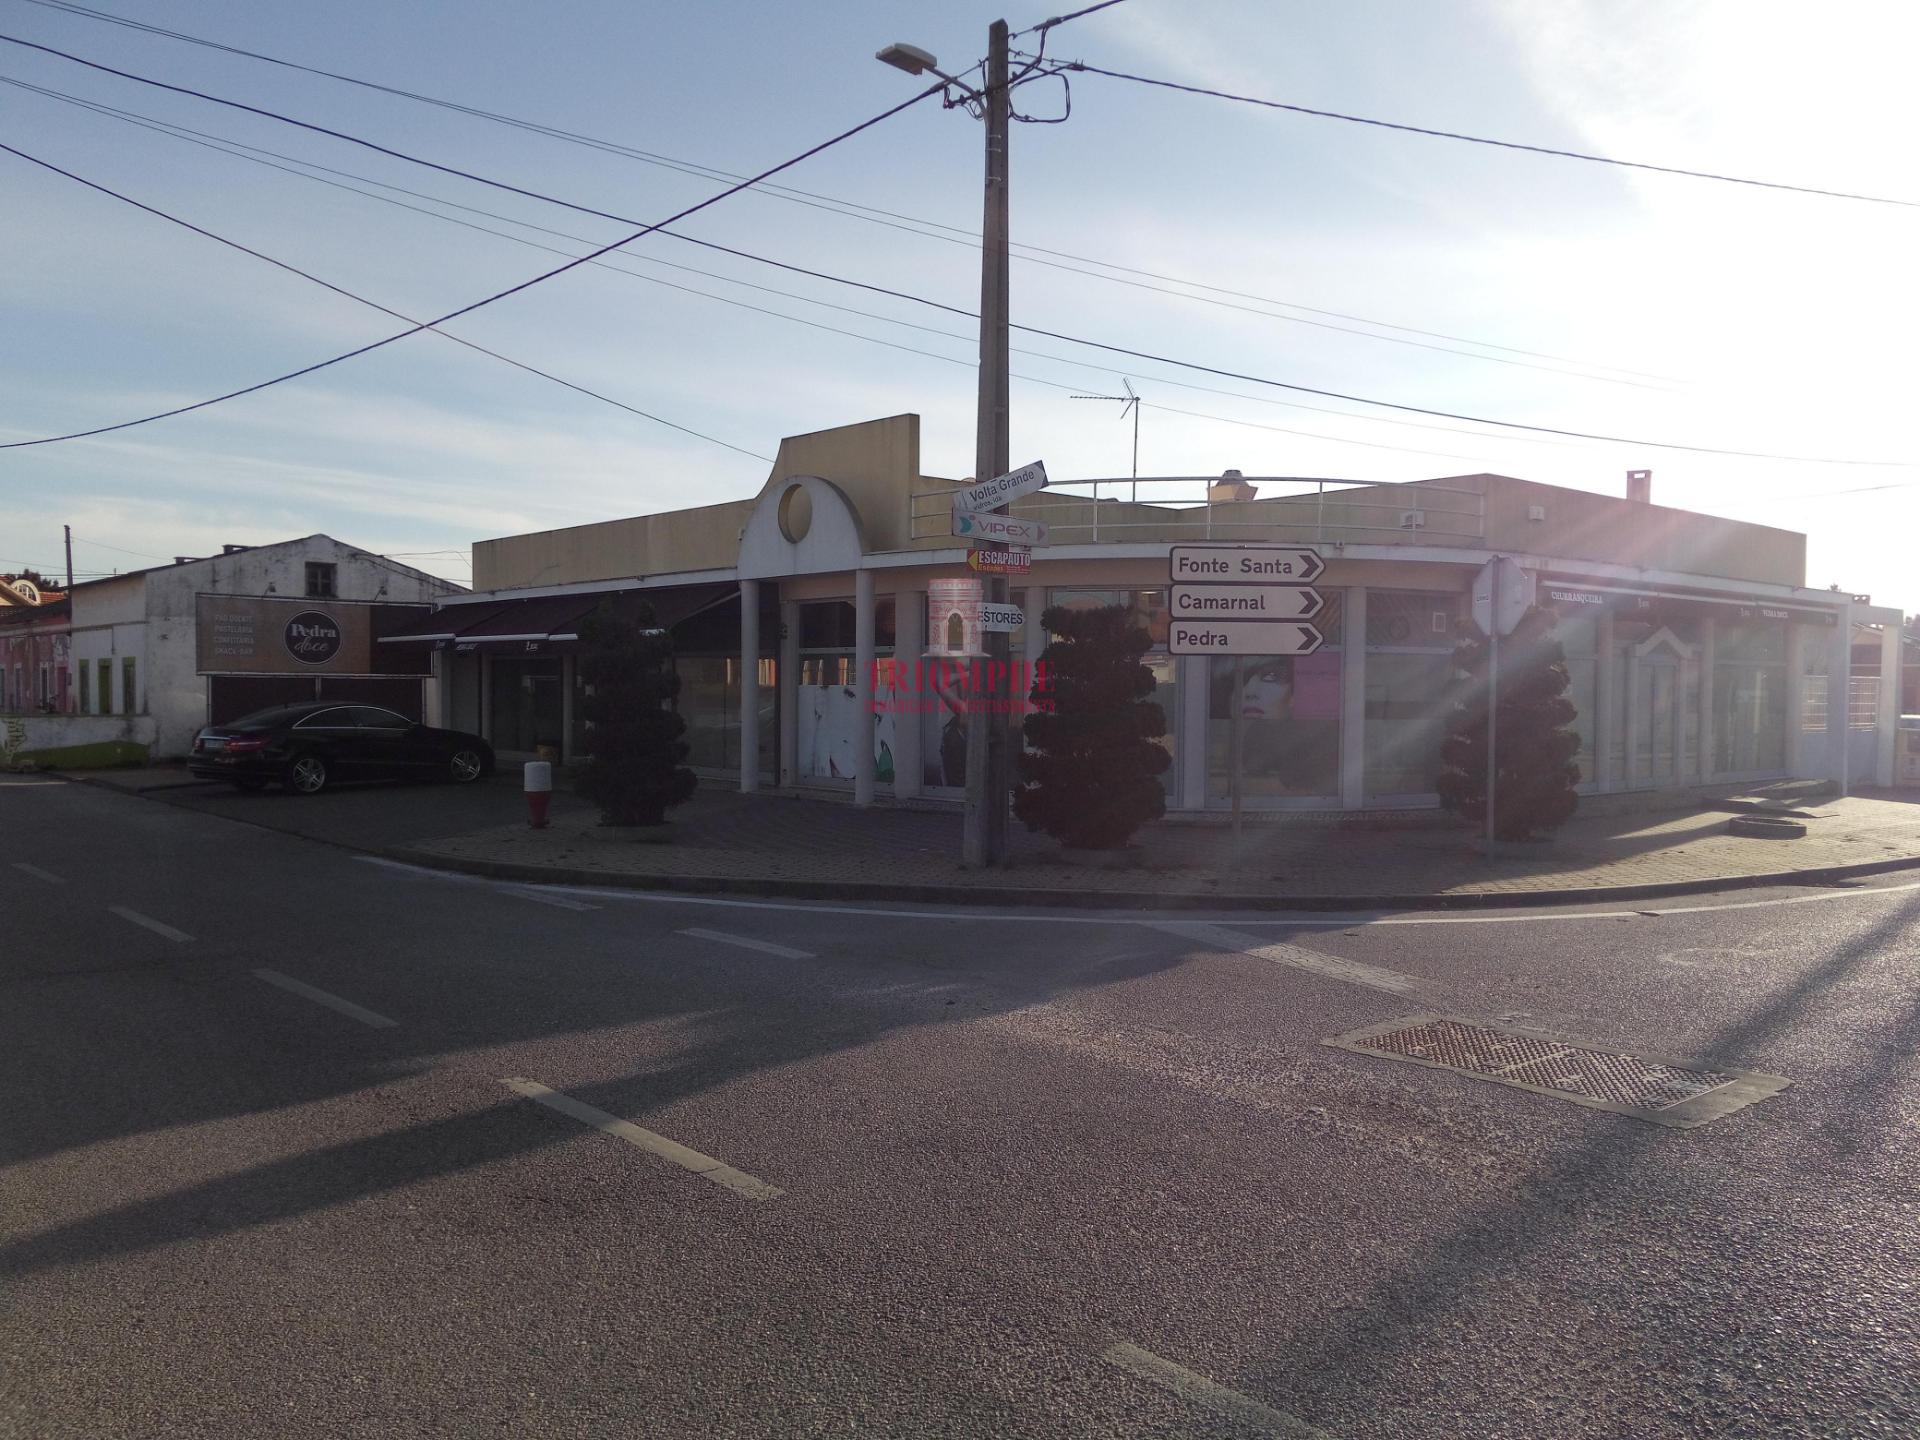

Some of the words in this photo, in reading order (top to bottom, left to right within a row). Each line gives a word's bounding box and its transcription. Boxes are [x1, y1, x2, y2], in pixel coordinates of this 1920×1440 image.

[969, 485, 998, 502] Volta
[998, 470, 1035, 491] Grande
[978, 520, 1031, 538] VIPEX
[978, 550, 1031, 566] ESCAPAUTO
[1178, 557, 1229, 573] Fonte
[1240, 558, 1292, 574] Santa
[1178, 594, 1266, 610] Camarnal
[1551, 591, 1604, 604] CHURRASQUEIRA
[977, 610, 1023, 625] ESTORES
[291, 623, 336, 638] Pedra
[1176, 630, 1229, 646] Pedra
[294, 635, 329, 654] doce
